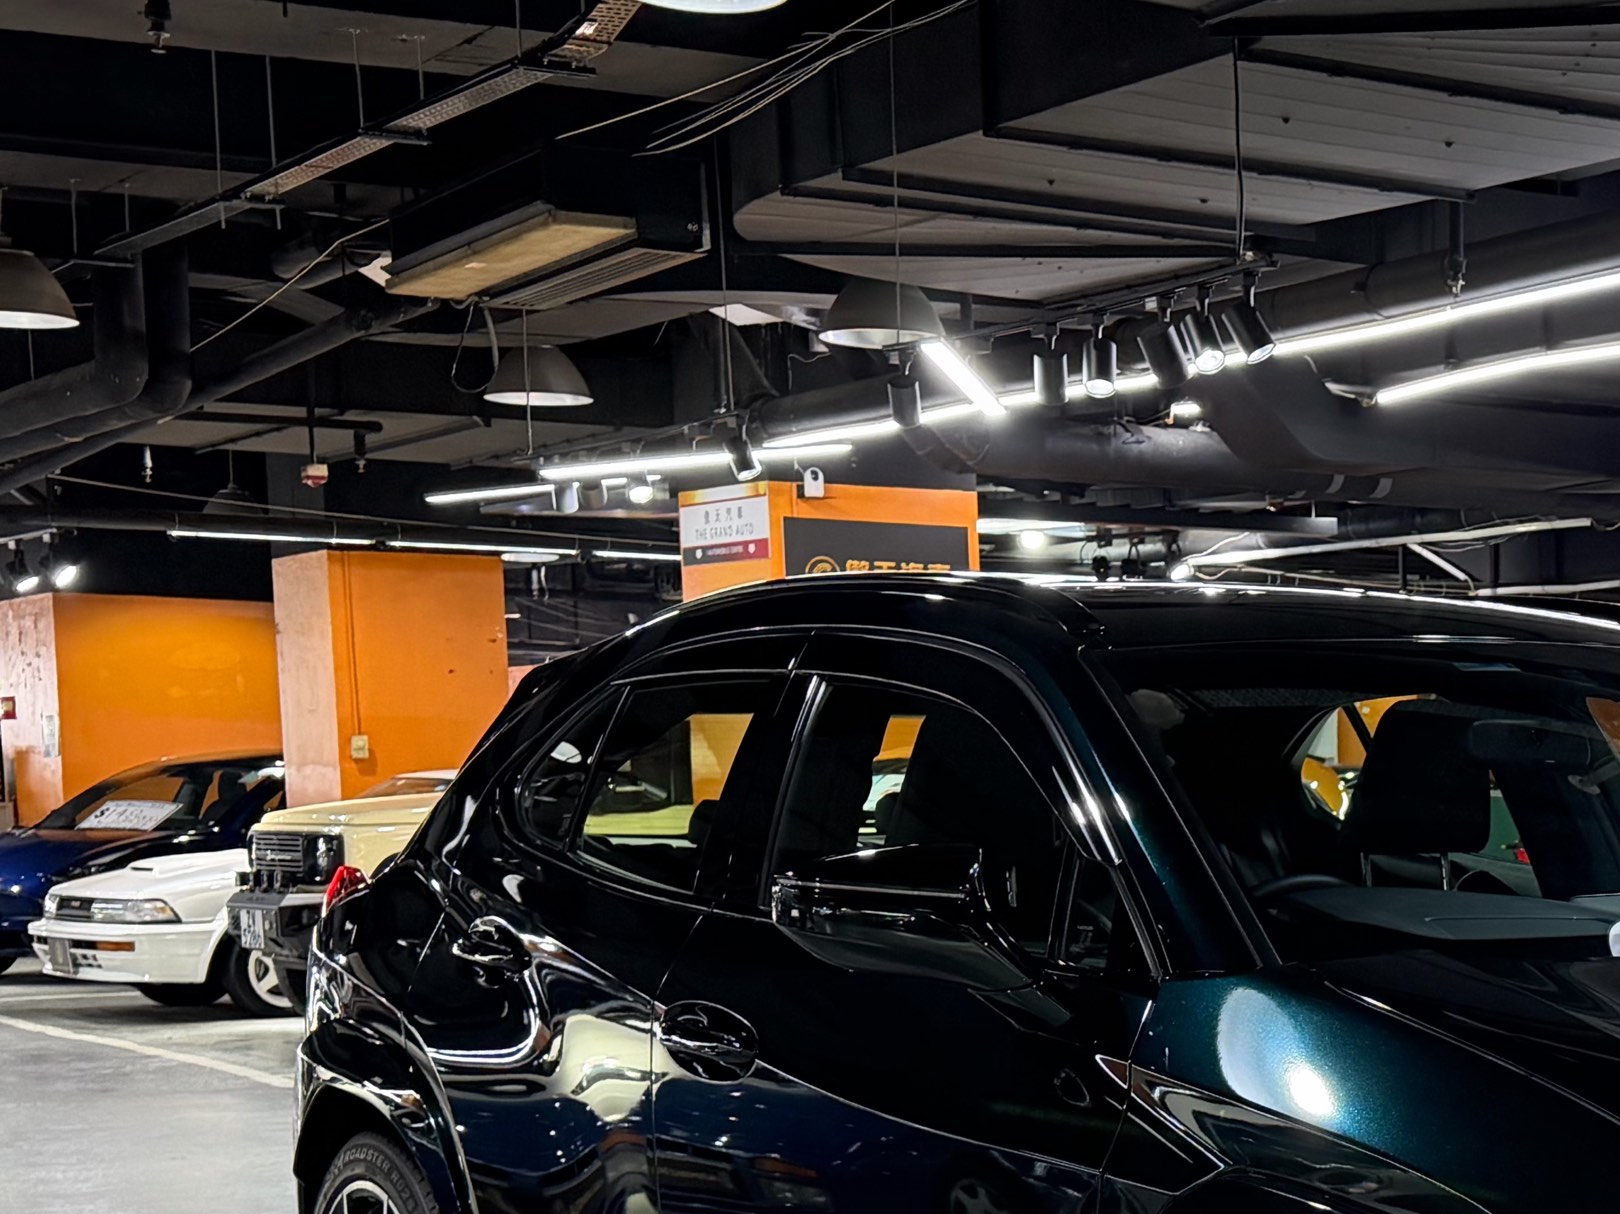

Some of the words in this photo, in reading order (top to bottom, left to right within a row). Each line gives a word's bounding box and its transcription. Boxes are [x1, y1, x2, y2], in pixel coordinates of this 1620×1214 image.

[695, 527, 708, 540] THE
[710, 524, 733, 540] GRAND
[735, 521, 754, 537] AUTO
[343, 1147, 391, 1173] ROADSTER
